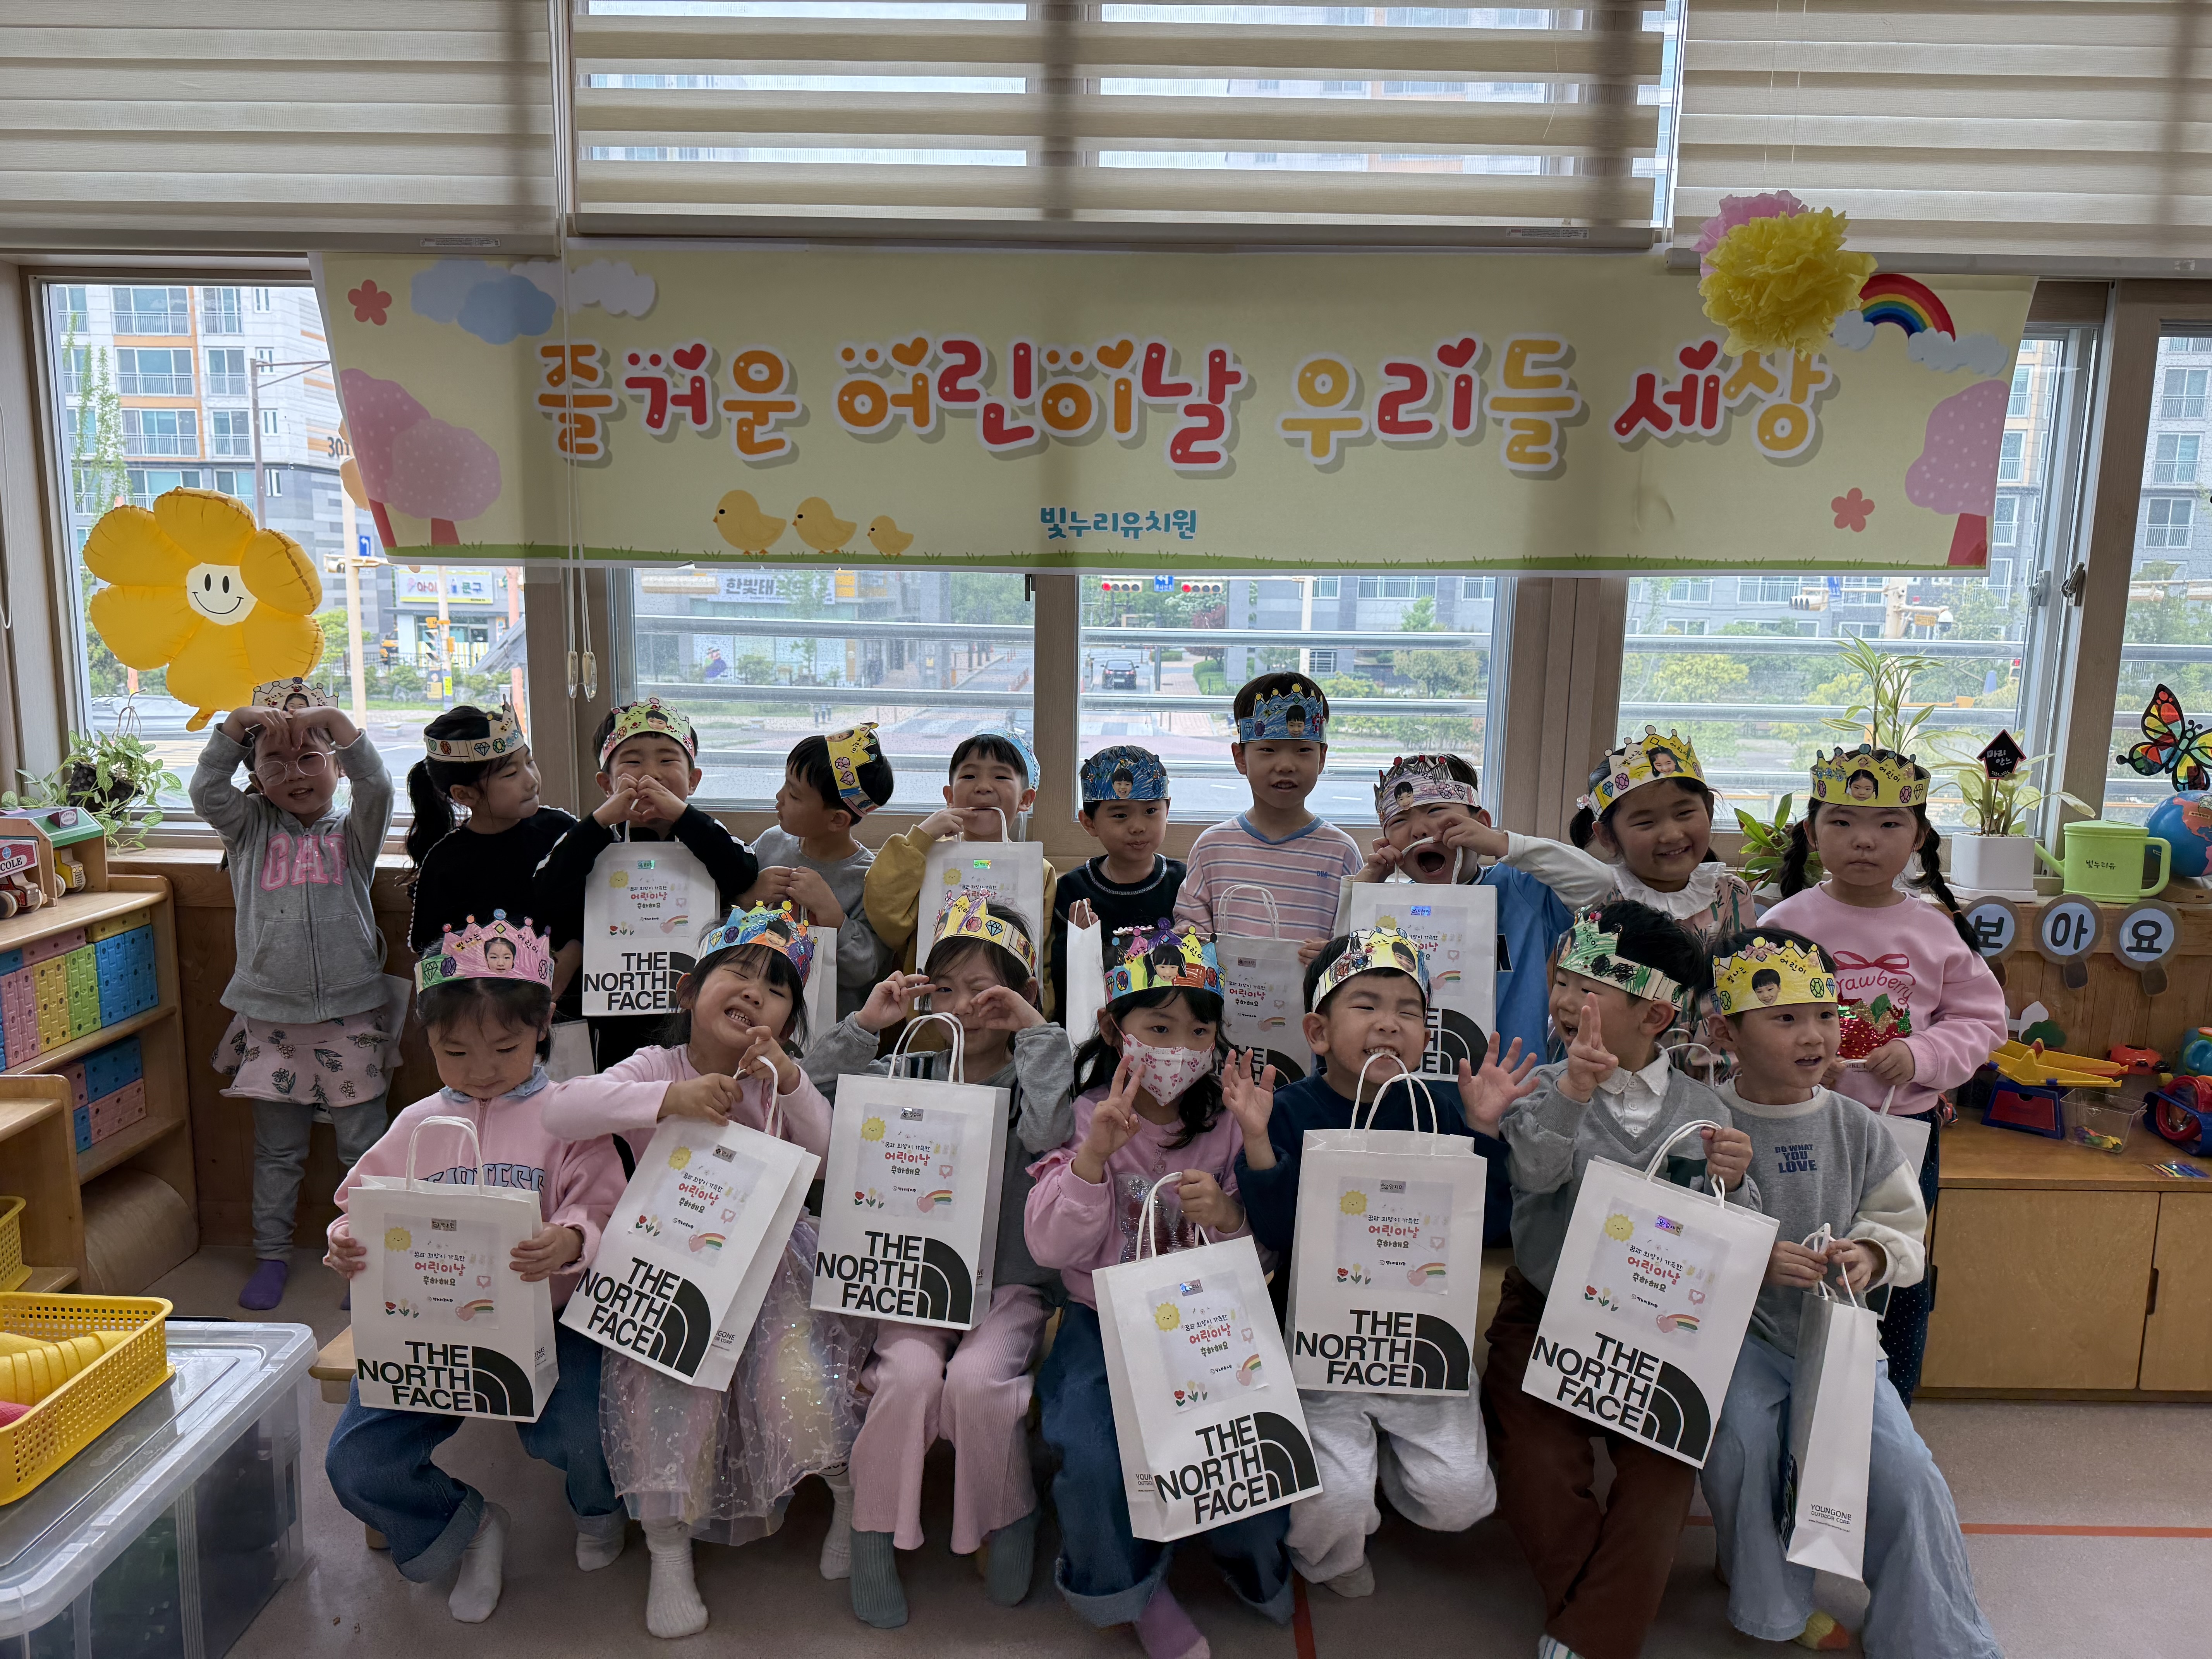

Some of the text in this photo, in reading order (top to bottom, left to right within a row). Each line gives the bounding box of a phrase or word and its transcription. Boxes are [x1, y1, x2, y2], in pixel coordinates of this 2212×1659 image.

[538, 337, 1826, 465] 즐거운 어린이날 우리들 세상
[1041, 507, 1197, 539] 빛누리유치원
[1987, 750, 2006, 758] 마리
[1996, 757, 2012, 766] 안느
[1879, 766, 1900, 782] 어린이
[0, 857, 22, 871] COLE
[631, 892, 667, 900] 어린이날
[456, 934, 539, 953] 빛나는 어린이
[1182, 942, 1204, 961] 어린이
[621, 952, 667, 971] THE
[1780, 958, 1807, 974] 어린이
[584, 971, 667, 992] NORTH
[1836, 970, 1913, 1008] rawberry
[608, 991, 667, 1010] FACE
[1230, 989, 1266, 1000] 어린이날
[885, 1151, 930, 1166] 어린이날
[1778, 1160, 1817, 1173] LOVE
[1782, 1151, 1808, 1161] YOU
[891, 1165, 920, 1175] 축하해요
[678, 1183, 719, 1206] 어린이날
[679, 1197, 705, 1213] 축하해요
[1368, 1224, 1419, 1238] 어린이날
[865, 1230, 922, 1262] THE
[1377, 1238, 1409, 1248] 축하해요
[415, 1261, 466, 1276] 어린이날
[1630, 1245, 1683, 1271] 꿈과 희망이 가득한
[423, 1275, 456, 1286] 축하해요
[627, 1257, 681, 1301] THE
[815, 1252, 919, 1290] NORTH
[1628, 1257, 1681, 1285] 어린이날
[1633, 1272, 1666, 1292] 축하해요
[575, 1268, 669, 1328] NORTH
[842, 1282, 916, 1316] FACE
[587, 1304, 655, 1355] FACE
[1189, 1323, 1231, 1344] 어린이날
[1350, 1309, 1413, 1337] THE
[405, 1340, 468, 1368] THE
[1200, 1341, 1229, 1357] 축하해요
[1295, 1331, 1412, 1363] NORTH
[1595, 1331, 1659, 1383] THE
[357, 1358, 470, 1391] NORTH
[1327, 1360, 1410, 1387] FACE
[1532, 1336, 1651, 1407] NORTH
[392, 1385, 473, 1412] FACE
[1556, 1376, 1643, 1432] FACE
[1195, 1414, 1255, 1456] THE
[1154, 1444, 1261, 1503] NORTH
[1193, 1475, 1266, 1525] FACE
[1811, 1504, 1851, 1521] YOUNGONE
[1811, 1511, 1834, 1521] OUTDOOR
